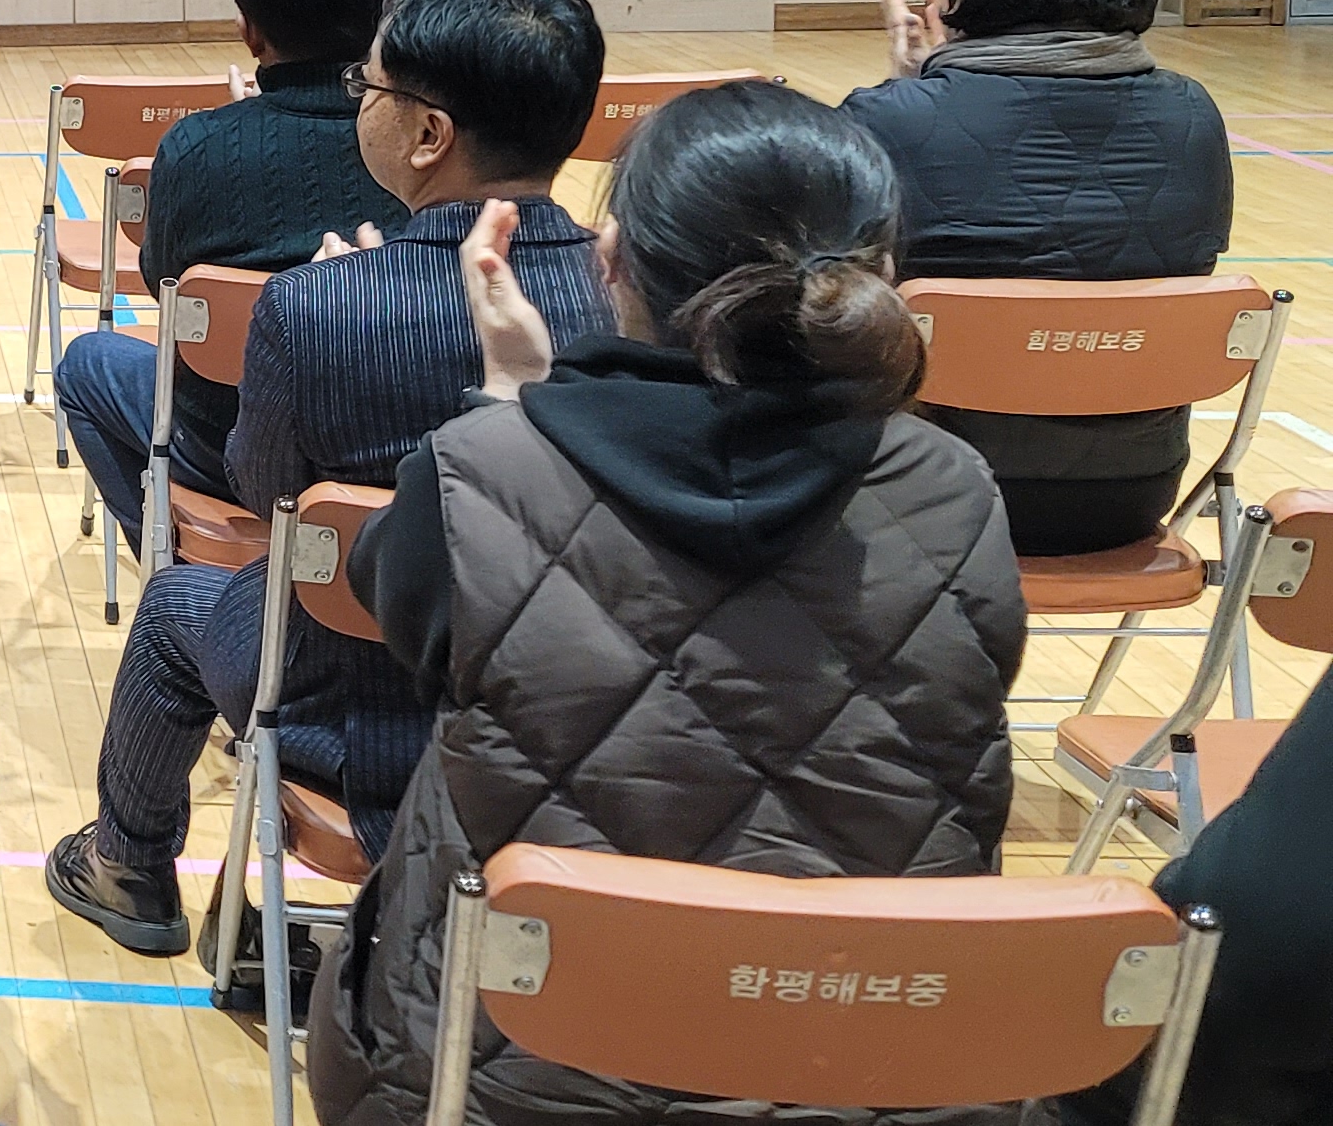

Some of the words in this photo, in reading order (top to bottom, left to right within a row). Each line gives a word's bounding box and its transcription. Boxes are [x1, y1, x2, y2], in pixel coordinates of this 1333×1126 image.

[141, 106, 216, 122] 함평해
[1025, 329, 1146, 353] 함평해보중
[728, 963, 948, 1007] 함평해보중
